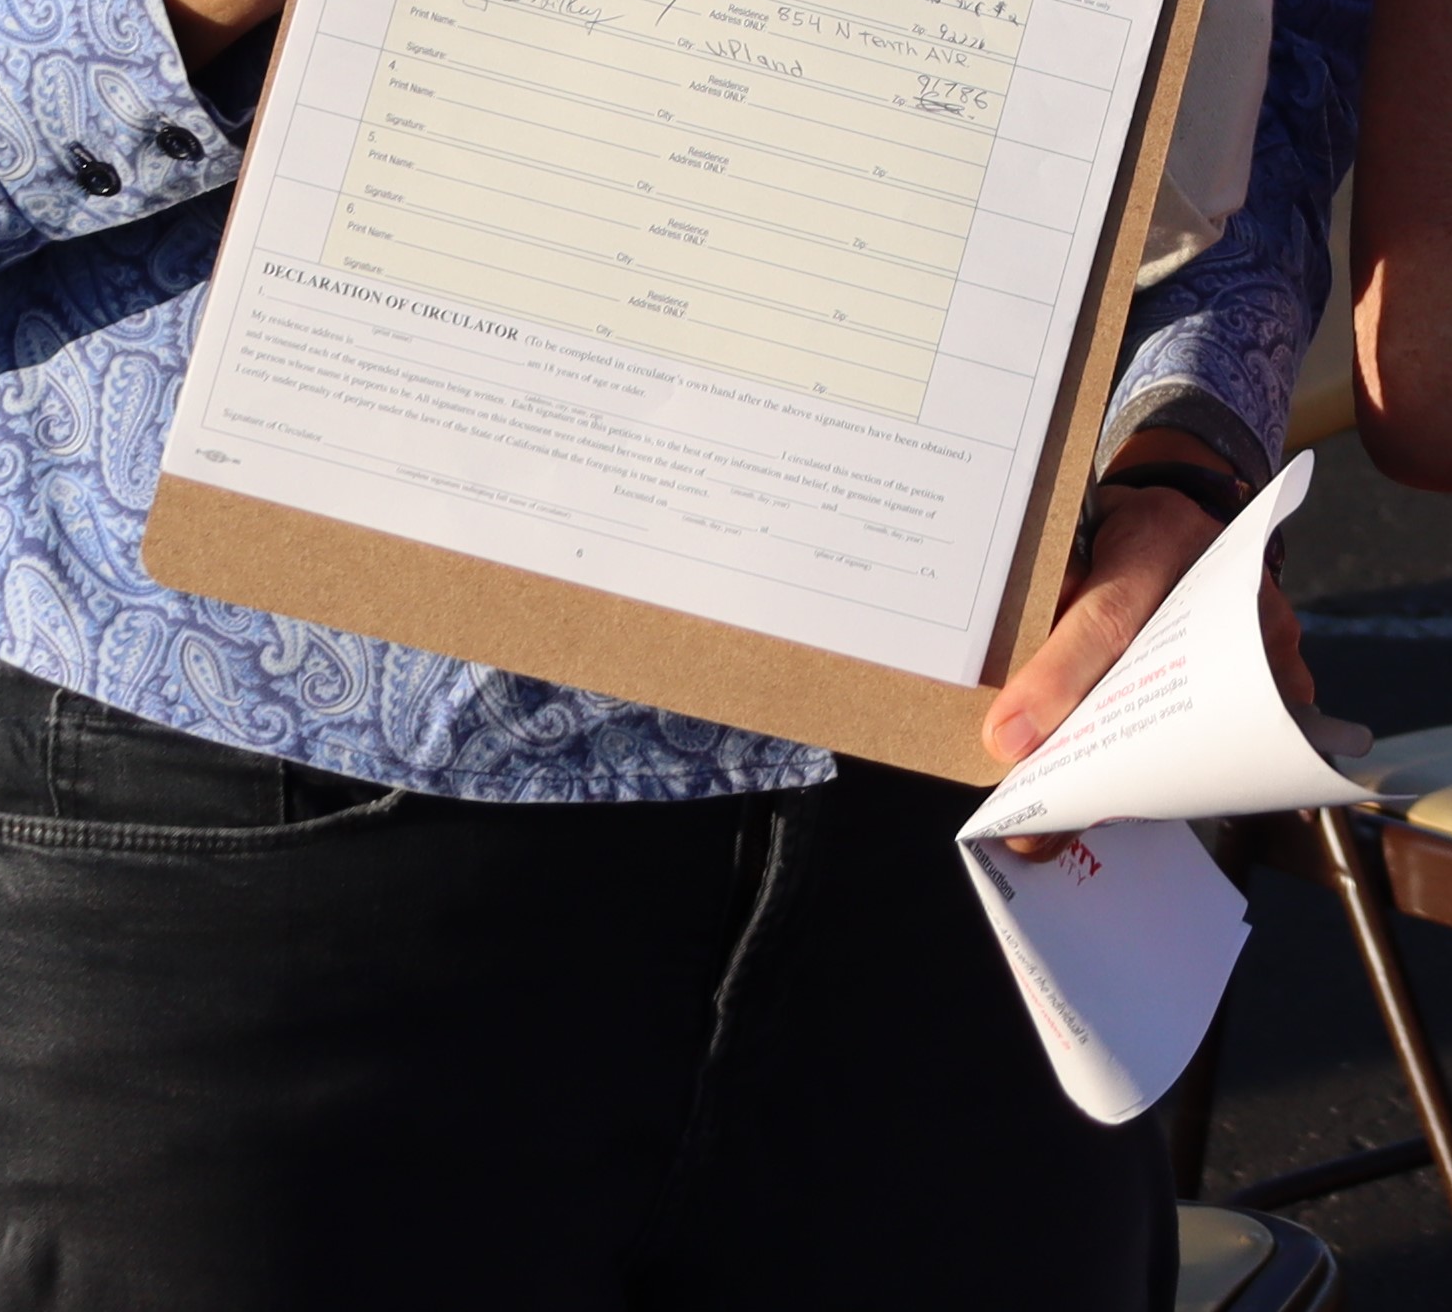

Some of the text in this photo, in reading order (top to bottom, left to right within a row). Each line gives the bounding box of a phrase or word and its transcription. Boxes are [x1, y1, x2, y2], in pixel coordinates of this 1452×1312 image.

[262, 261, 518, 341] DECLARATION OF CIRCULATOR
[1138, 667, 1167, 688] SAME
[1137, 675, 1189, 710] registered
[1163, 697, 1193, 721] Please
[1120, 715, 1158, 739] initially
[1074, 740, 1100, 762] what
[1101, 730, 1118, 750] ask
[1038, 753, 1072, 778] county
